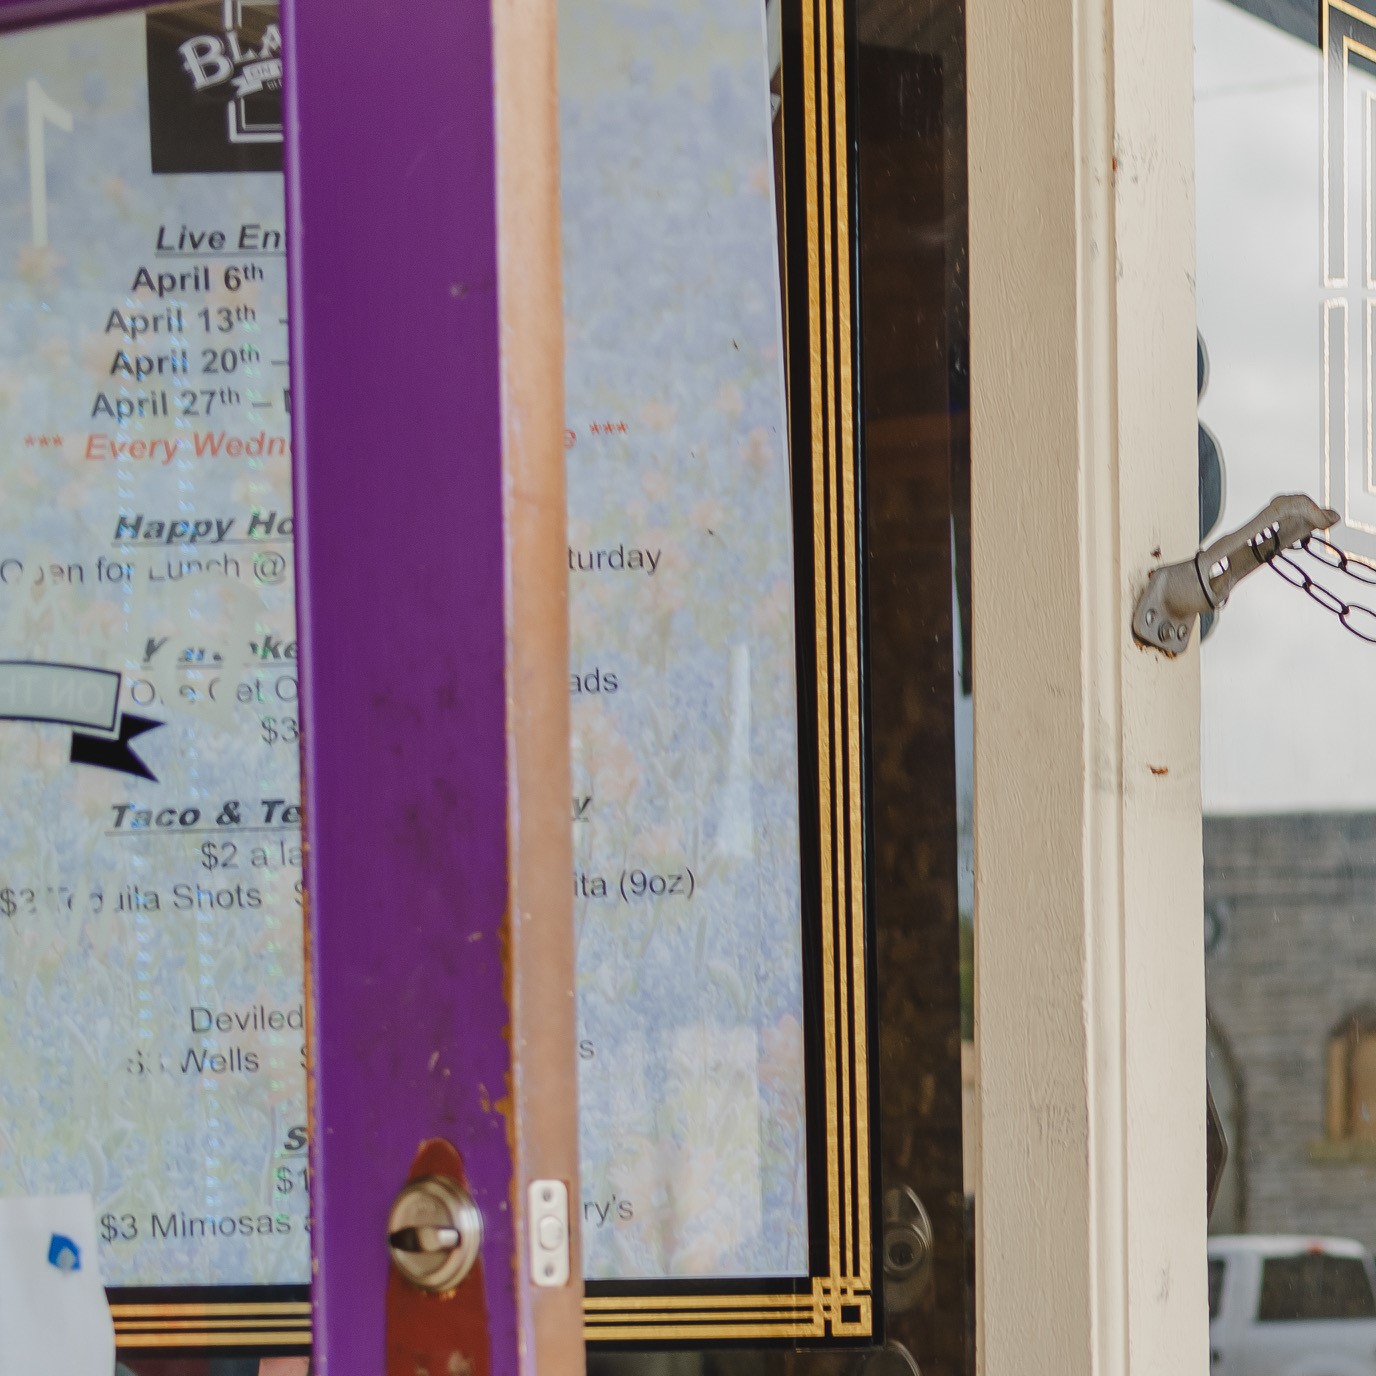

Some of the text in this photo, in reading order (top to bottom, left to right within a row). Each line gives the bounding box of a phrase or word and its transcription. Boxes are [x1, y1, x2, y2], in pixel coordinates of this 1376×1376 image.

[156, 225, 226, 250] Live
[132, 263, 264, 298] April 6th
[105, 304, 256, 339] April 13th
[111, 345, 260, 382] April 20th
[91, 391, 168, 424] April
[180, 386, 240, 417] 27th
[85, 433, 178, 465] Every
[114, 513, 235, 543] Happy
[97, 556, 131, 584] for
[111, 804, 201, 829] Taco
[215, 799, 243, 827] &
[201, 840, 240, 871] $2
[250, 846, 268, 868] a
[173, 882, 263, 911] Shots
[620, 867, 696, 902] (9oz)
[189, 1004, 304, 1034] Deviled
[100, 1213, 138, 1245] $3
[150, 1210, 292, 1239] Mimosas
